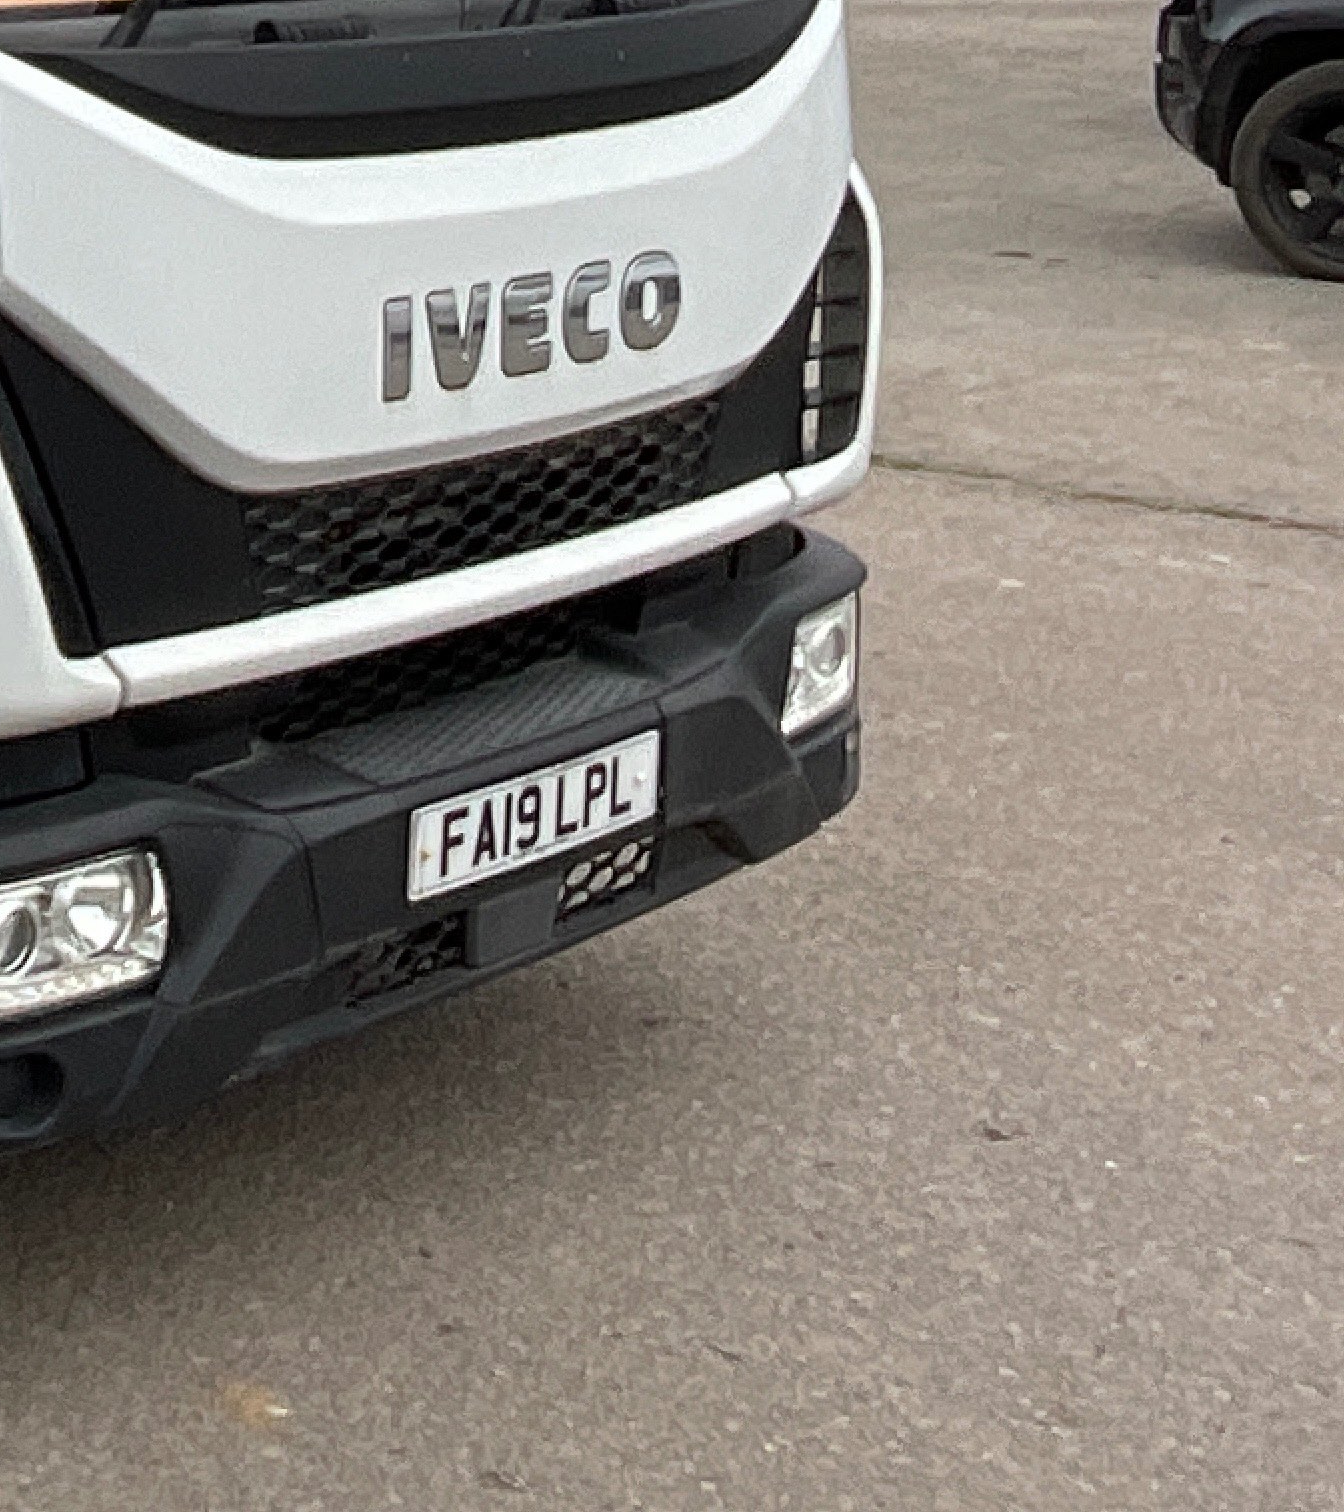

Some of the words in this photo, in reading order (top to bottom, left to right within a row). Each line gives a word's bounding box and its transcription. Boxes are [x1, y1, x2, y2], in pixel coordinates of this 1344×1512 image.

[381, 248, 681, 404] IVECO
[438, 784, 542, 878] FA19
[554, 754, 632, 838] LPL
